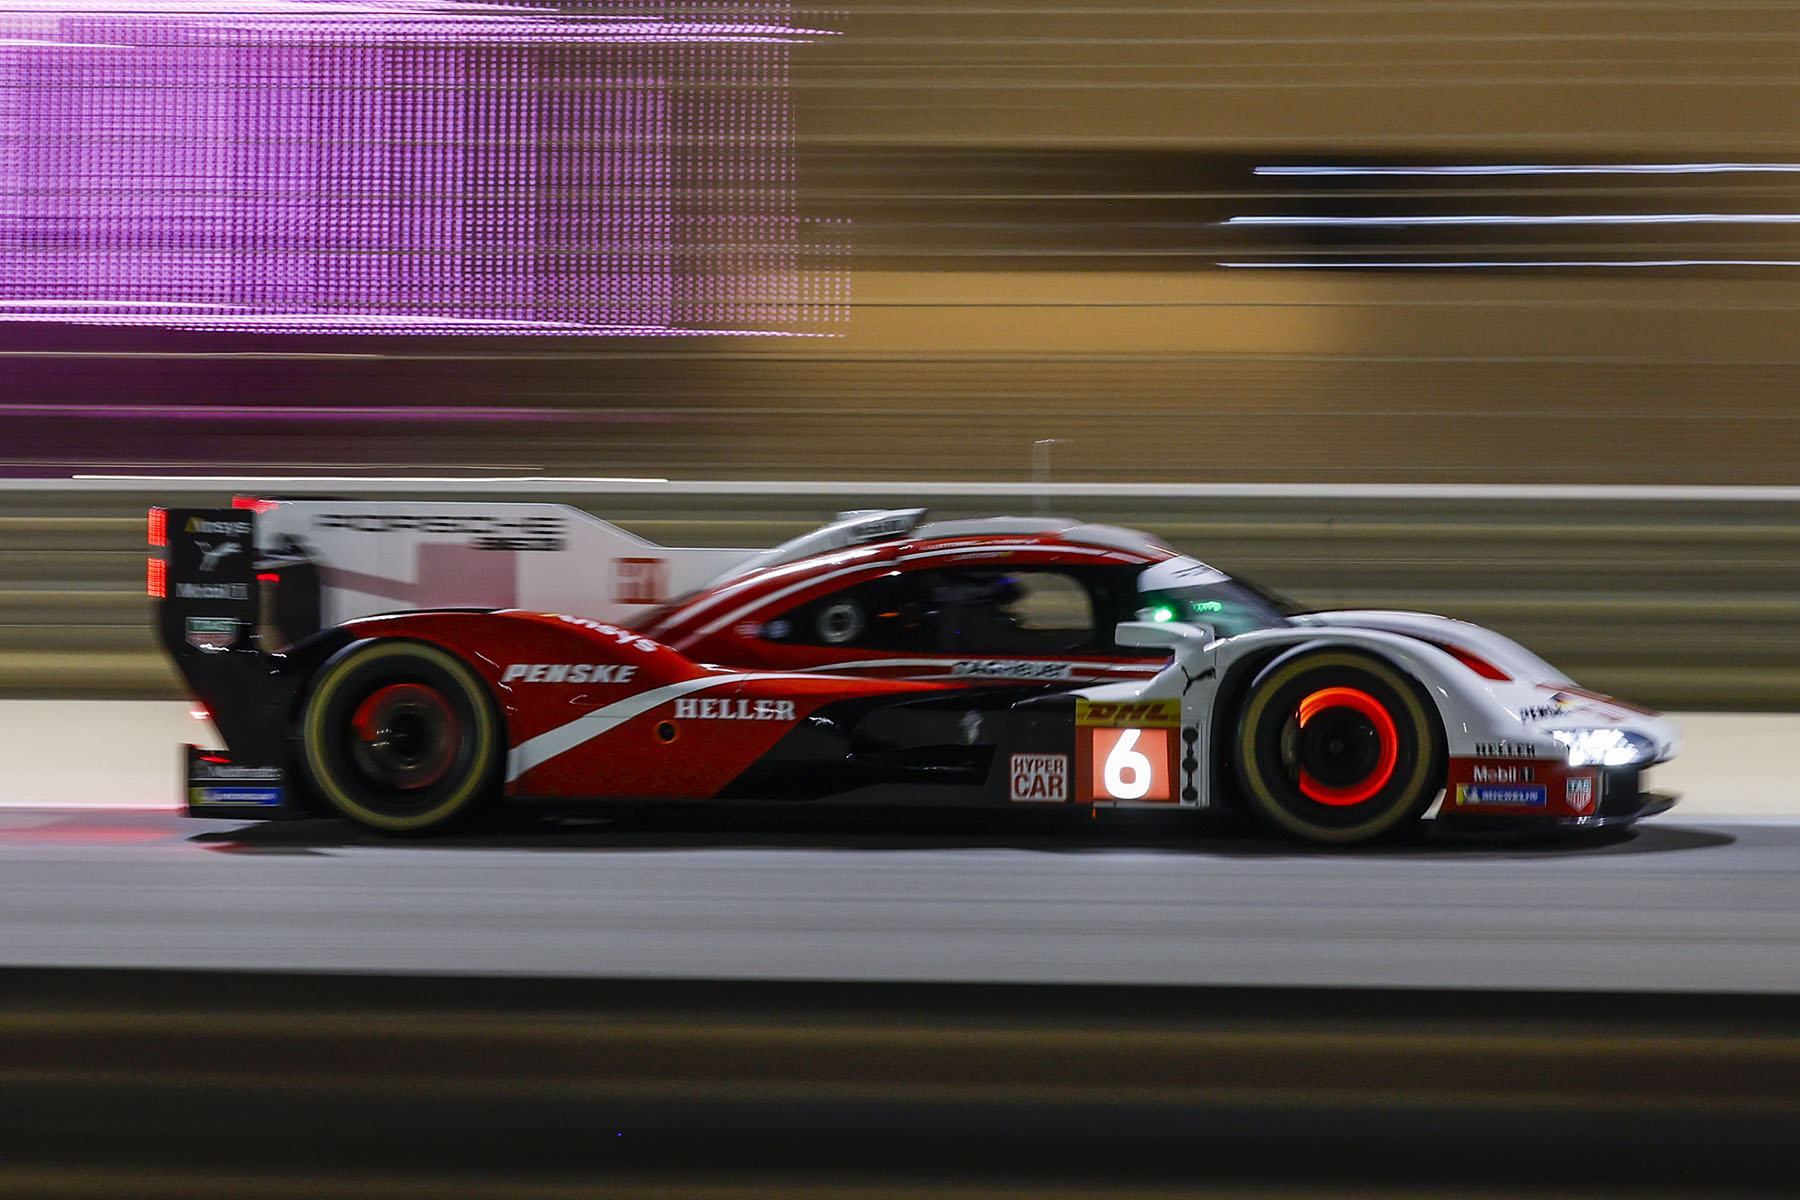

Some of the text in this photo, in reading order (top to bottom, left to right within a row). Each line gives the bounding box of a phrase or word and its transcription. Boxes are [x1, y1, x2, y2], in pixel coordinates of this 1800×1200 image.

[502, 664, 638, 683] PENSKE
[674, 698, 797, 720] HELLER
[1085, 704, 1168, 720] DHL
[1013, 758, 1064, 773] HYPER
[1104, 728, 1152, 799] 6
[1473, 765, 1517, 782] Mobil
[1014, 776, 1063, 797] CAR
